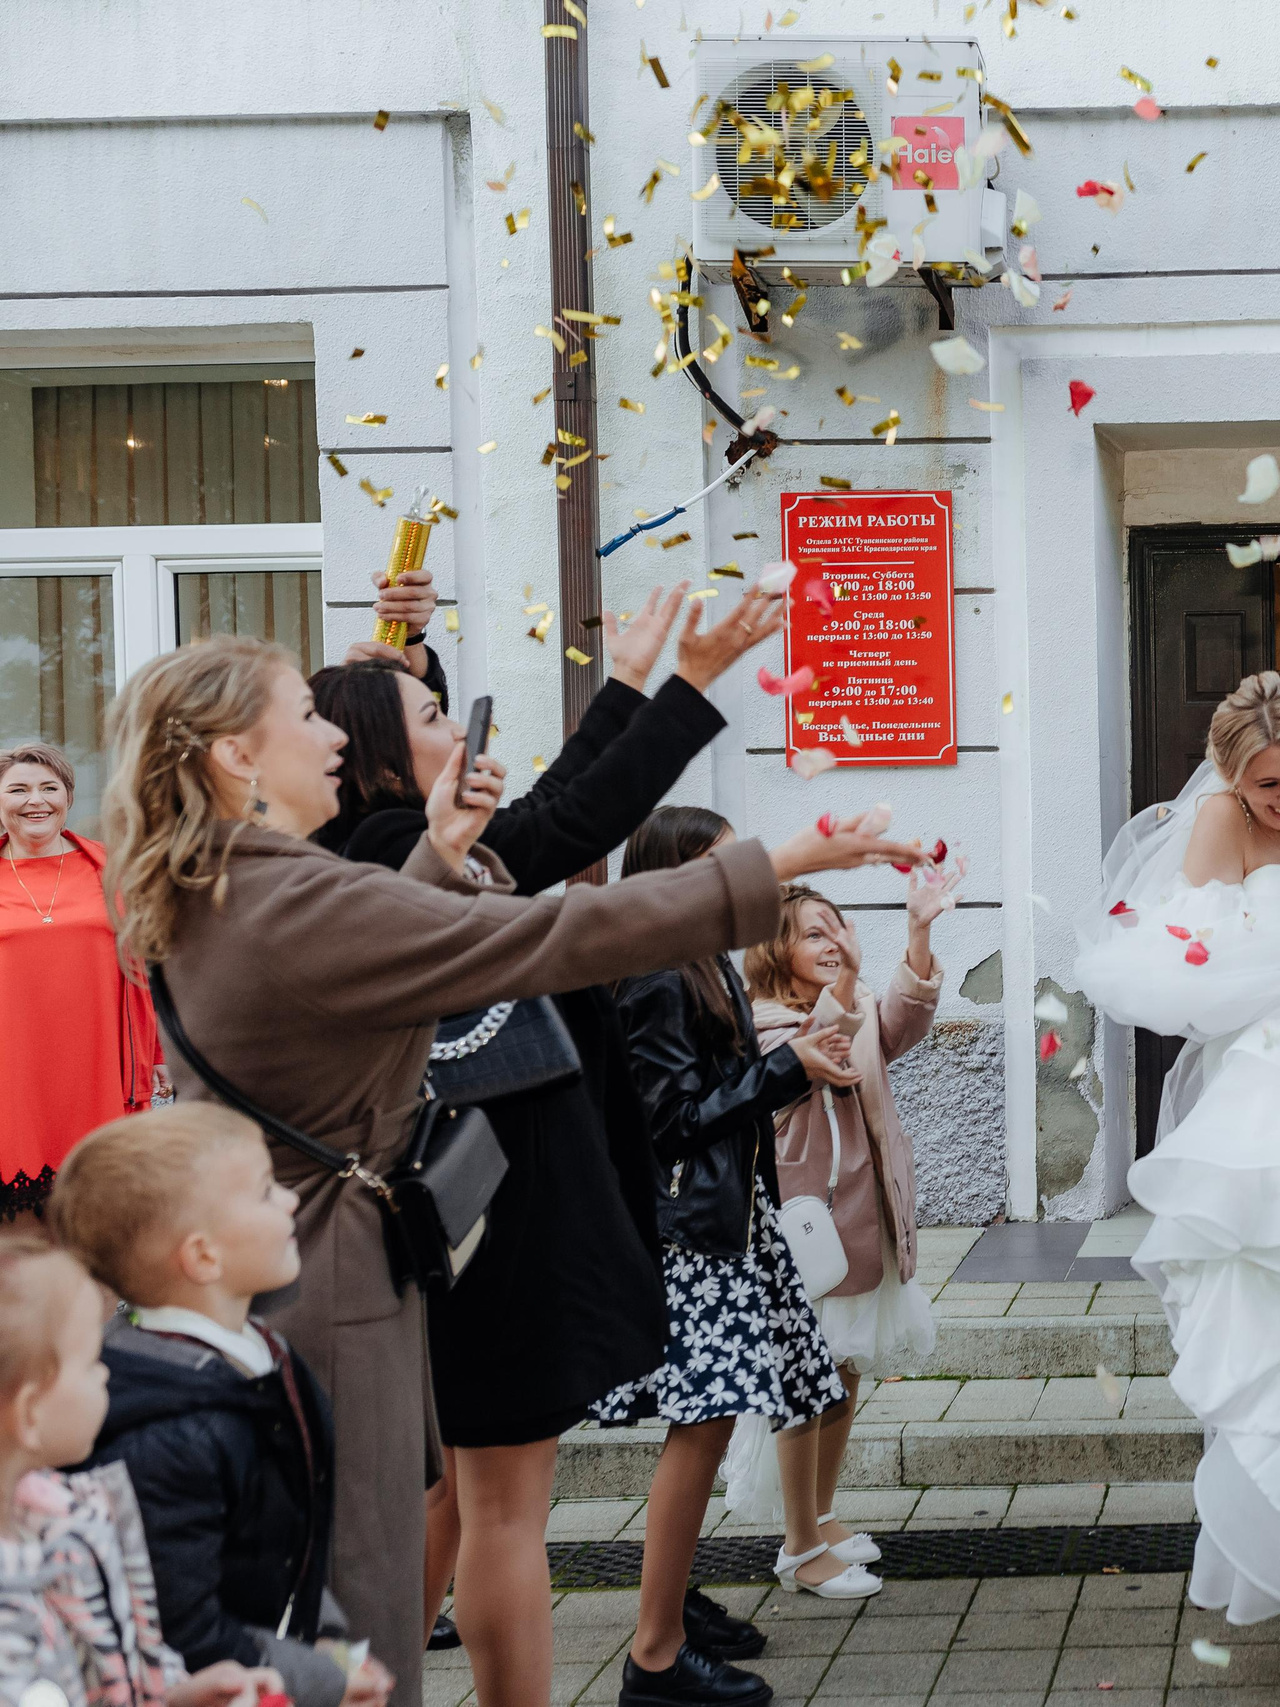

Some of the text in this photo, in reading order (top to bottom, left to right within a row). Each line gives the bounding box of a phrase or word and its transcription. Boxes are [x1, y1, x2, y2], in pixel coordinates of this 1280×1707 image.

[798, 513, 936, 528] РЕЖИМ РАБОТЫ
[832, 537, 854, 545] ЗАГС
[903, 536, 929, 545] района
[798, 545, 938, 555] Управления ЗАГС Краснодарского края
[822, 571, 915, 581] Вторник, Суббота
[861, 584, 875, 592] до
[877, 580, 915, 591] 18:00
[861, 592, 888, 601] 13:00
[905, 591, 932, 601] 13:50
[853, 610, 885, 621] Среда
[822, 619, 916, 632] с 9:00 до 18:00
[806, 634, 852, 643] перерыв
[862, 631, 889, 640] 13:00
[890, 633, 904, 641] до
[906, 630, 933, 640] 13:50
[849, 650, 892, 660] Четверг
[822, 658, 918, 668] не приемный день
[847, 676, 894, 685] Пятница
[831, 685, 863, 697] 9:00
[864, 689, 877, 697] до
[880, 685, 918, 696] 17:00
[808, 699, 853, 709] перерыв
[863, 697, 891, 706] 13:00
[907, 696, 934, 705] 13:40
[802, 721, 942, 731] Воскреснье, Понедельник
[818, 731, 925, 742] Выхдные дни
